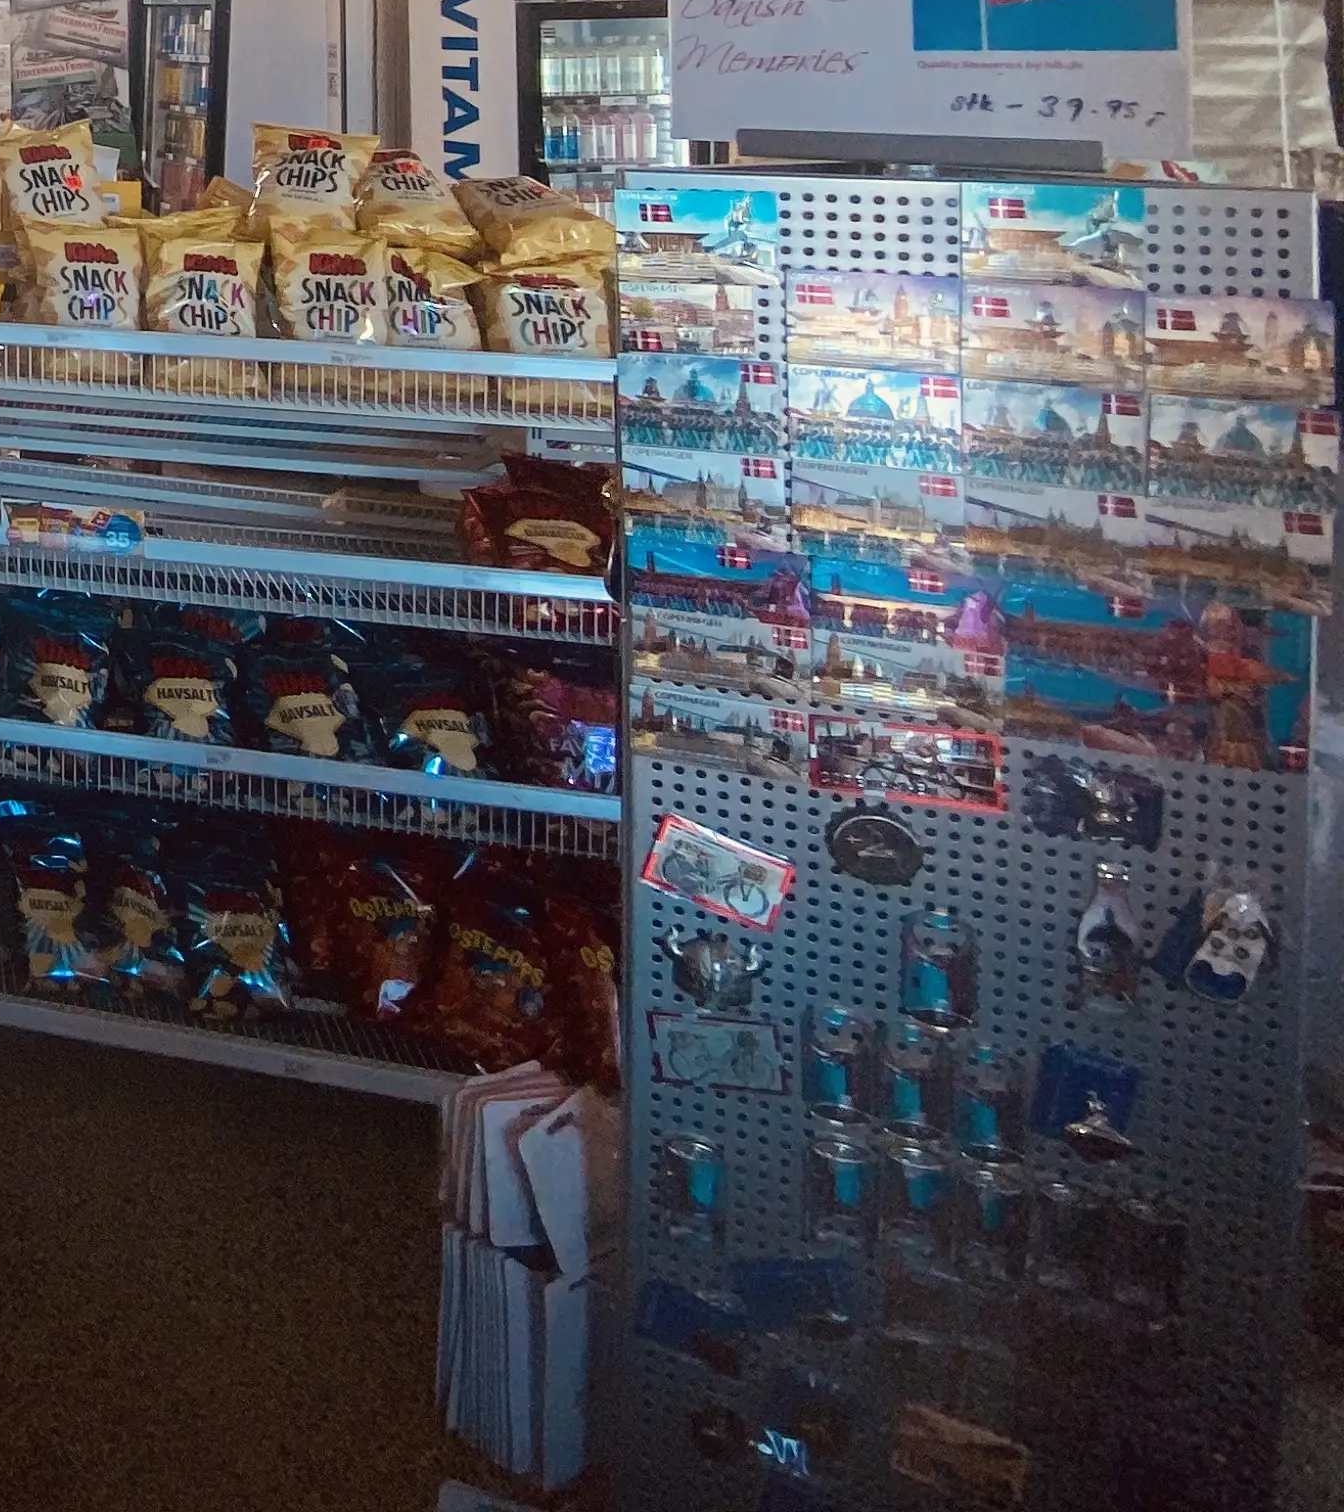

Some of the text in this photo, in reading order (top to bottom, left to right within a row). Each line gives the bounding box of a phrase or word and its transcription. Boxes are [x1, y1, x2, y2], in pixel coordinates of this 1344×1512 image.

[676, 35, 869, 75] Memories
[276, 166, 338, 193] CHIPS
[31, 186, 90, 217] CHIPS
[59, 265, 130, 296] SNACK
[175, 274, 246, 309] SNACK
[300, 277, 377, 307] SNACK
[67, 292, 128, 323] CHIPS
[178, 303, 241, 336] CHIPS
[391, 303, 457, 337] CHIPS
[509, 292, 592, 320] SNACK
[520, 316, 588, 348] CHIPS
[106, 531, 130, 548] 35
[156, 687, 213, 702] HAVSALT
[278, 702, 336, 724] HAVSALT
[414, 718, 470, 734] HAVSAL
